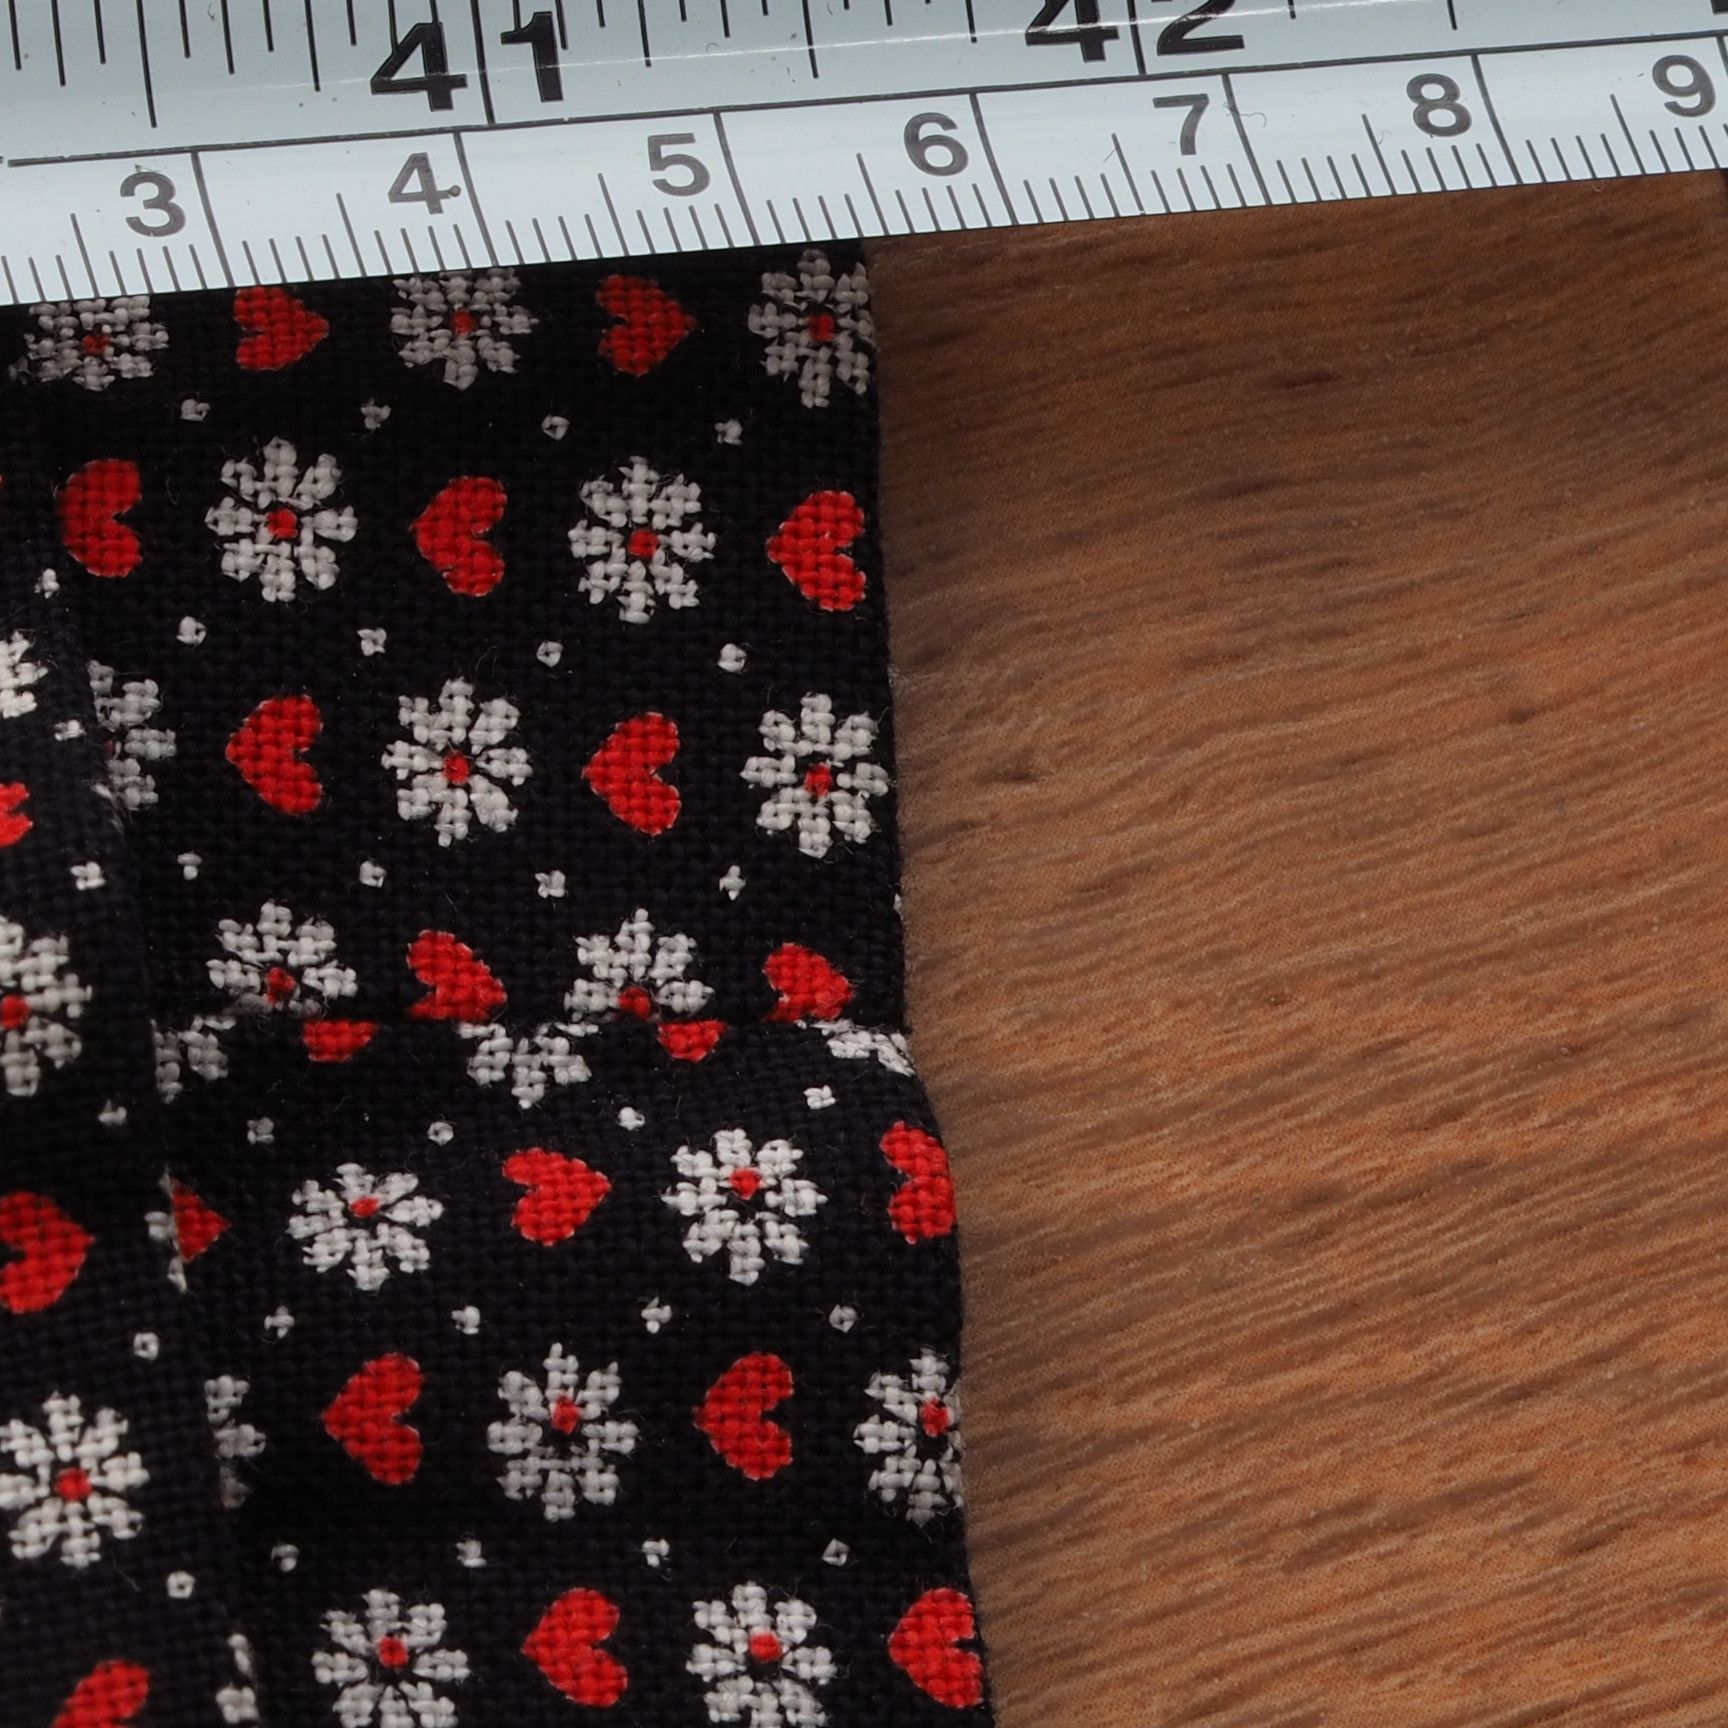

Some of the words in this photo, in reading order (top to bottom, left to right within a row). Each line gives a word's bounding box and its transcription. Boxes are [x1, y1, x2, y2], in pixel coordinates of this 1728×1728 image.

[370, 11, 563, 112] 41
[119, 171, 186, 238] 3
[387, 152, 456, 215] 4
[646, 132, 711, 197] 5
[902, 111, 969, 177] 6
[1152, 92, 1211, 156] 7
[1405, 73, 1472, 138] 8
[1651, 54, 1717, 118] 9
